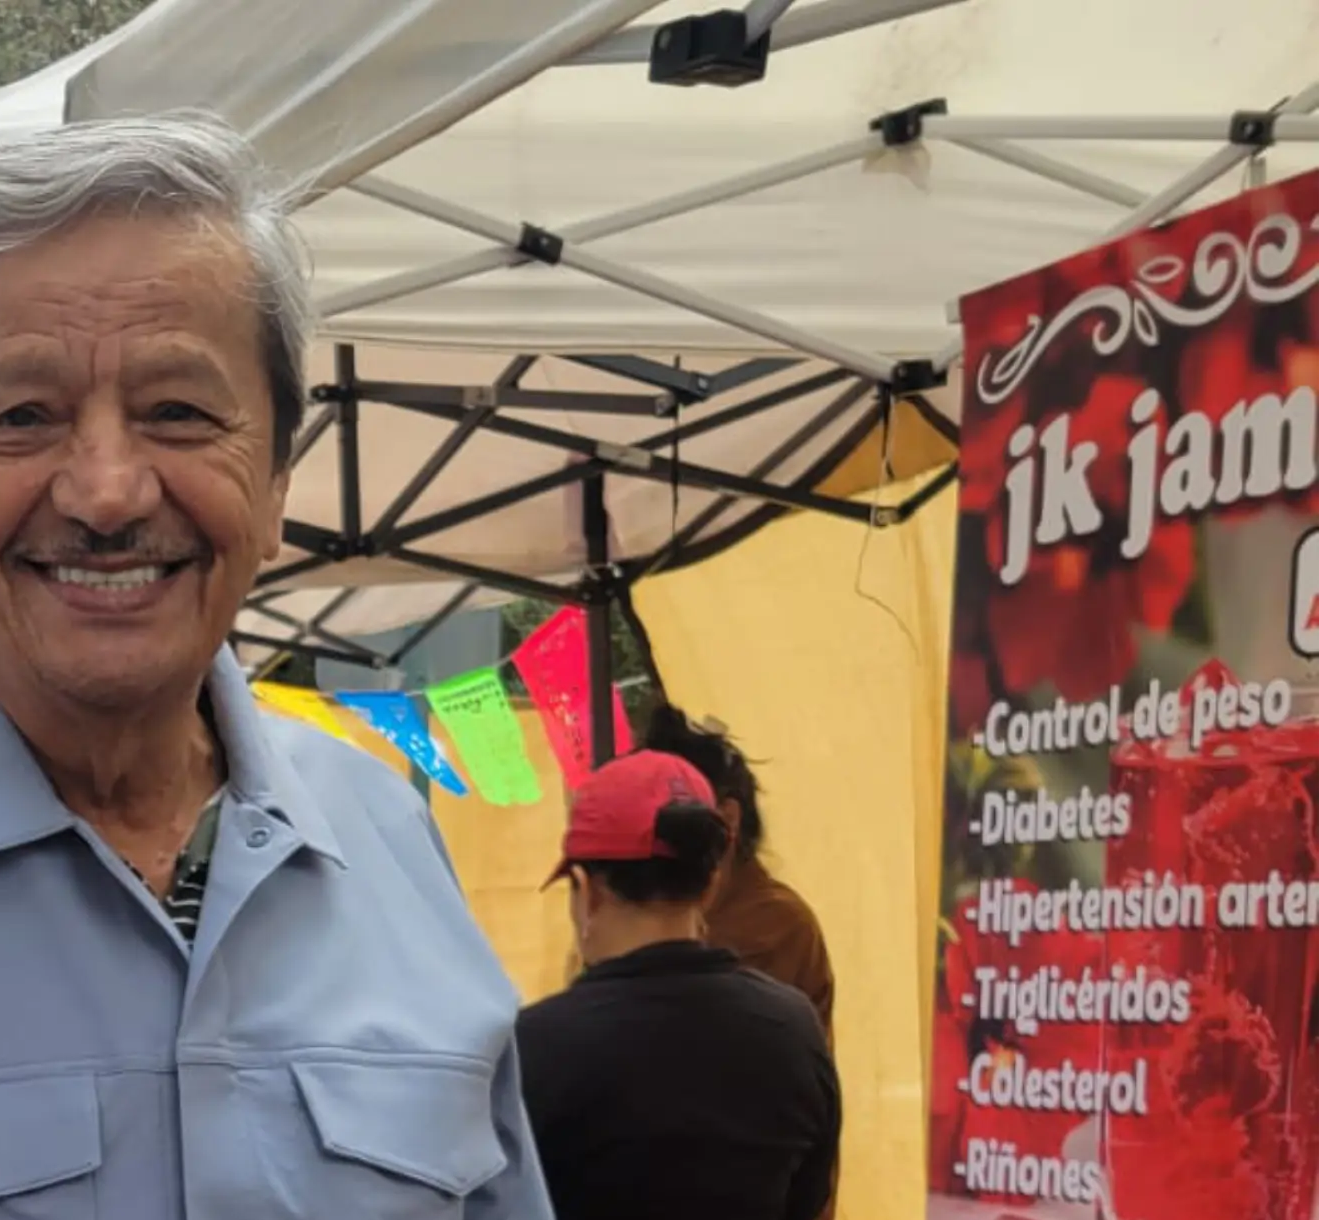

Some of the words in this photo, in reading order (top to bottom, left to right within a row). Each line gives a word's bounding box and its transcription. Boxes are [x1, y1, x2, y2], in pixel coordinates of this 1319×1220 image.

[1000, 413, 1102, 585] jk
[1121, 386, 1317, 559] jam
[973, 684, 1120, 756] -Control
[1134, 679, 1180, 738] de
[1192, 680, 1292, 749] peso
[969, 786, 1131, 845] -Diabetes
[965, 870, 1204, 946] -Hipertensión
[960, 965, 1191, 1035] -Triglicéridos
[957, 1052, 1147, 1114] -Colesterol
[954, 1138, 1101, 1203] -Riñones
